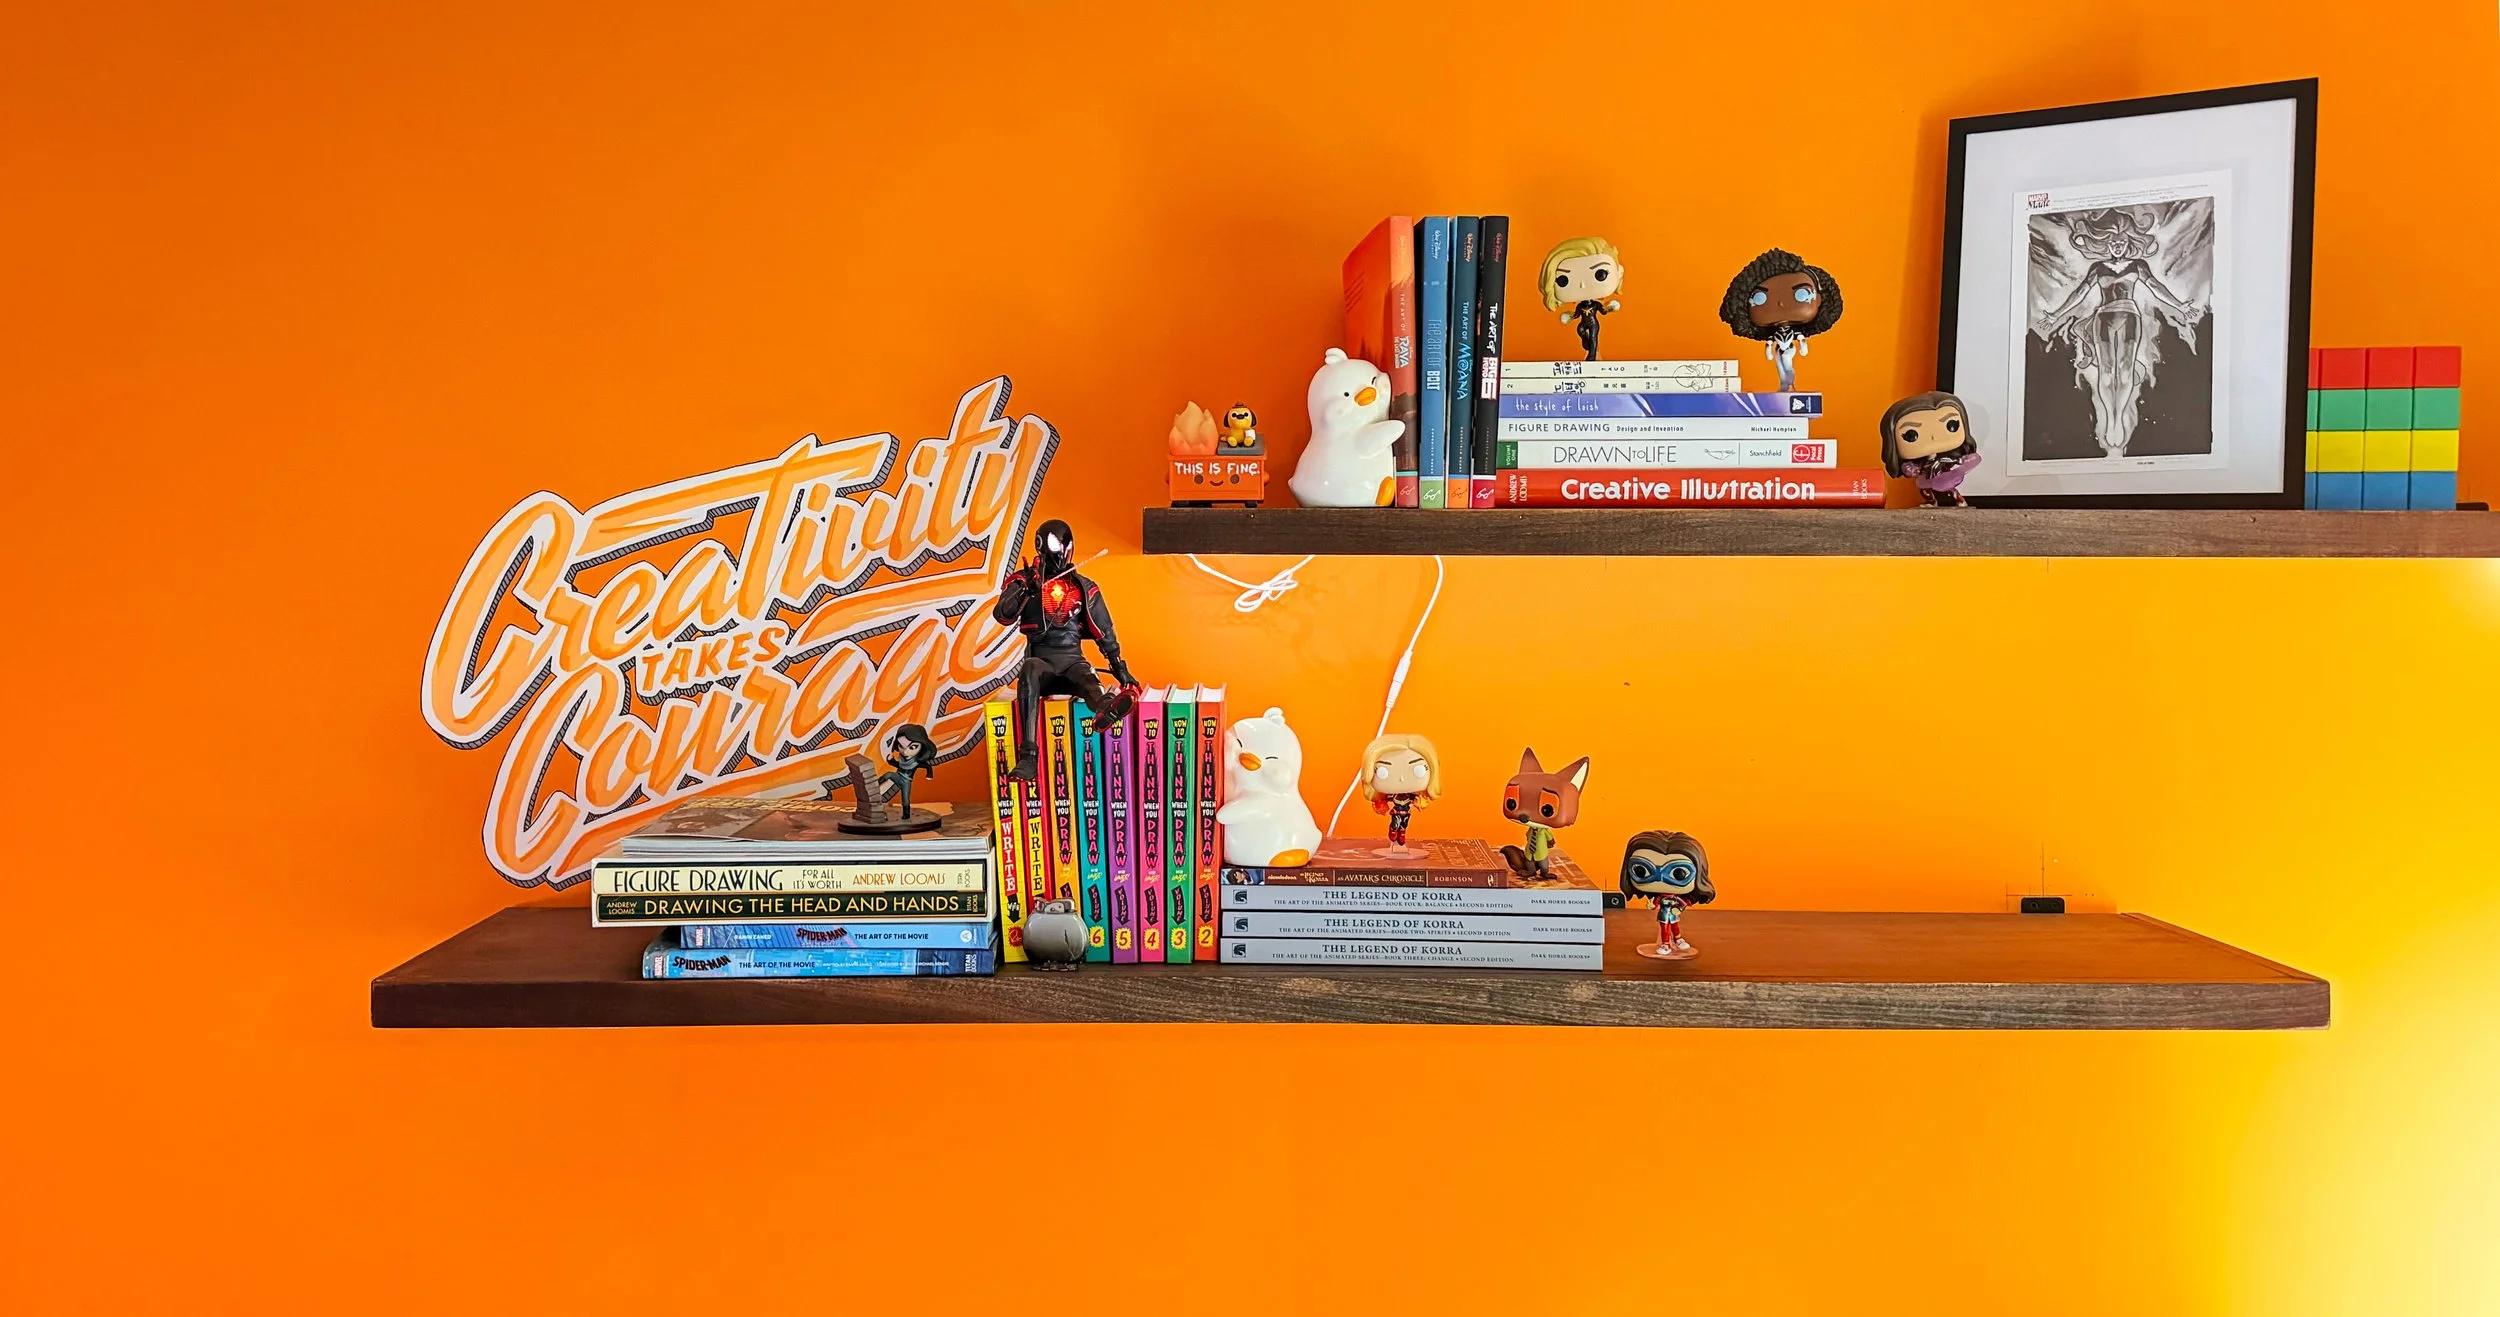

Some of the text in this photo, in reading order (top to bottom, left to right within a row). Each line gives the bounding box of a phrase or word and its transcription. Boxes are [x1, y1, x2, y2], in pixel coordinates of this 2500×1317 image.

[1488, 320, 1498, 342] ART
[1400, 336, 1410, 368] RAYA
[1457, 342, 1472, 400] MOANA
[1481, 357, 1489, 378] HERO
[1488, 357, 1499, 379] BIG
[1427, 370, 1441, 391] BOLT
[1481, 378, 1498, 400] 6
[1515, 397, 1599, 416] the style of loish
[1508, 423, 1549, 432] FIGURE
[1554, 423, 1610, 432] DRAWING
[1616, 425, 1638, 433] Design
[1554, 446, 1631, 463] DRAWN
[1646, 446, 1677, 463] LIFE
[1749, 449, 1782, 457] Stanchfield
[1174, 462, 1204, 475] THIS
[1209, 462, 1221, 475] IS
[1509, 473, 1517, 503] ANDREW
[1519, 475, 1528, 502] LOOMIS
[1561, 477, 1816, 500] Creative Illustration
[430, 380, 1046, 732] Creativity
[641, 625, 789, 693] TAKES
[993, 718, 1007, 726] HOW
[1052, 717, 1065, 726] HOW
[1145, 720, 1158, 729] HOW
[1173, 720, 1187, 728] HOW
[1203, 719, 1217, 727] HOW
[492, 594, 1026, 870] Courage
[996, 726, 1005, 734] TO
[1055, 726, 1064, 734] TO
[1084, 727, 1093, 735] TO
[1113, 728, 1122, 736] TO
[1148, 729, 1156, 737] TO
[1177, 728, 1185, 736] TO
[1206, 727, 1214, 735] TO
[997, 740, 1008, 798] THINK
[1055, 740, 1066, 797] THINK
[1084, 740, 1095, 798] THINK
[1112, 741, 1122, 800] THINK
[1147, 741, 1155, 800] THINK
[1175, 741, 1183, 799] THINK
[1204, 740, 1212, 799] THINK
[1055, 799, 1070, 807] WHEN
[1057, 807, 1069, 815] YOU
[1111, 801, 1127, 809] WHEN
[1143, 802, 1160, 810] WHEN
[1171, 801, 1188, 809] WHEN
[1200, 800, 1217, 808] WHEN
[1000, 808, 1013, 816] YOU
[1028, 808, 1041, 816] YOU
[1085, 808, 1098, 816] YOU
[1113, 809, 1125, 817] YOU
[1145, 810, 1158, 818] YOU
[1173, 809, 1186, 817] YOU
[1202, 808, 1214, 816] YOU
[1059, 816, 1072, 864] DRAW
[1087, 818, 1100, 865] DRAW
[1115, 819, 1127, 866] DRAW
[1146, 820, 1158, 868] DRAW
[1173, 819, 1186, 867] DRAW
[1201, 818, 1214, 866] DRAW
[1001, 821, 1016, 892] WRITE
[1030, 822, 1042, 891] WRITE
[614, 869, 783, 892] FIGURE DRAWING
[802, 869, 834, 879] FOR ALL
[852, 873, 895, 885] ANDREW
[900, 873, 945, 885] LOOMIS
[1381, 874, 1425, 883] CHRONICLE
[808, 880, 842, 889] WORTH
[1323, 891, 1462, 901] THE LEGEND OF KORRA
[606, 901, 638, 909] ANDREW
[644, 896, 959, 915] DRAWING THE HEAD AND HANDS
[1118, 888, 1128, 922] VOLUME
[1324, 918, 1464, 929] THE LEGEND OF KORRA
[796, 927, 848, 942] SPIDER-MAN
[1092, 928, 1101, 944] 6
[1119, 930, 1128, 946] 5
[1147, 931, 1157, 947] 4
[1173, 930, 1184, 946] 3
[1201, 929, 1211, 945] 2
[1322, 944, 1462, 955] THE LEGEND OF KORRA
[672, 955, 732, 971] SPIDER-MAN
